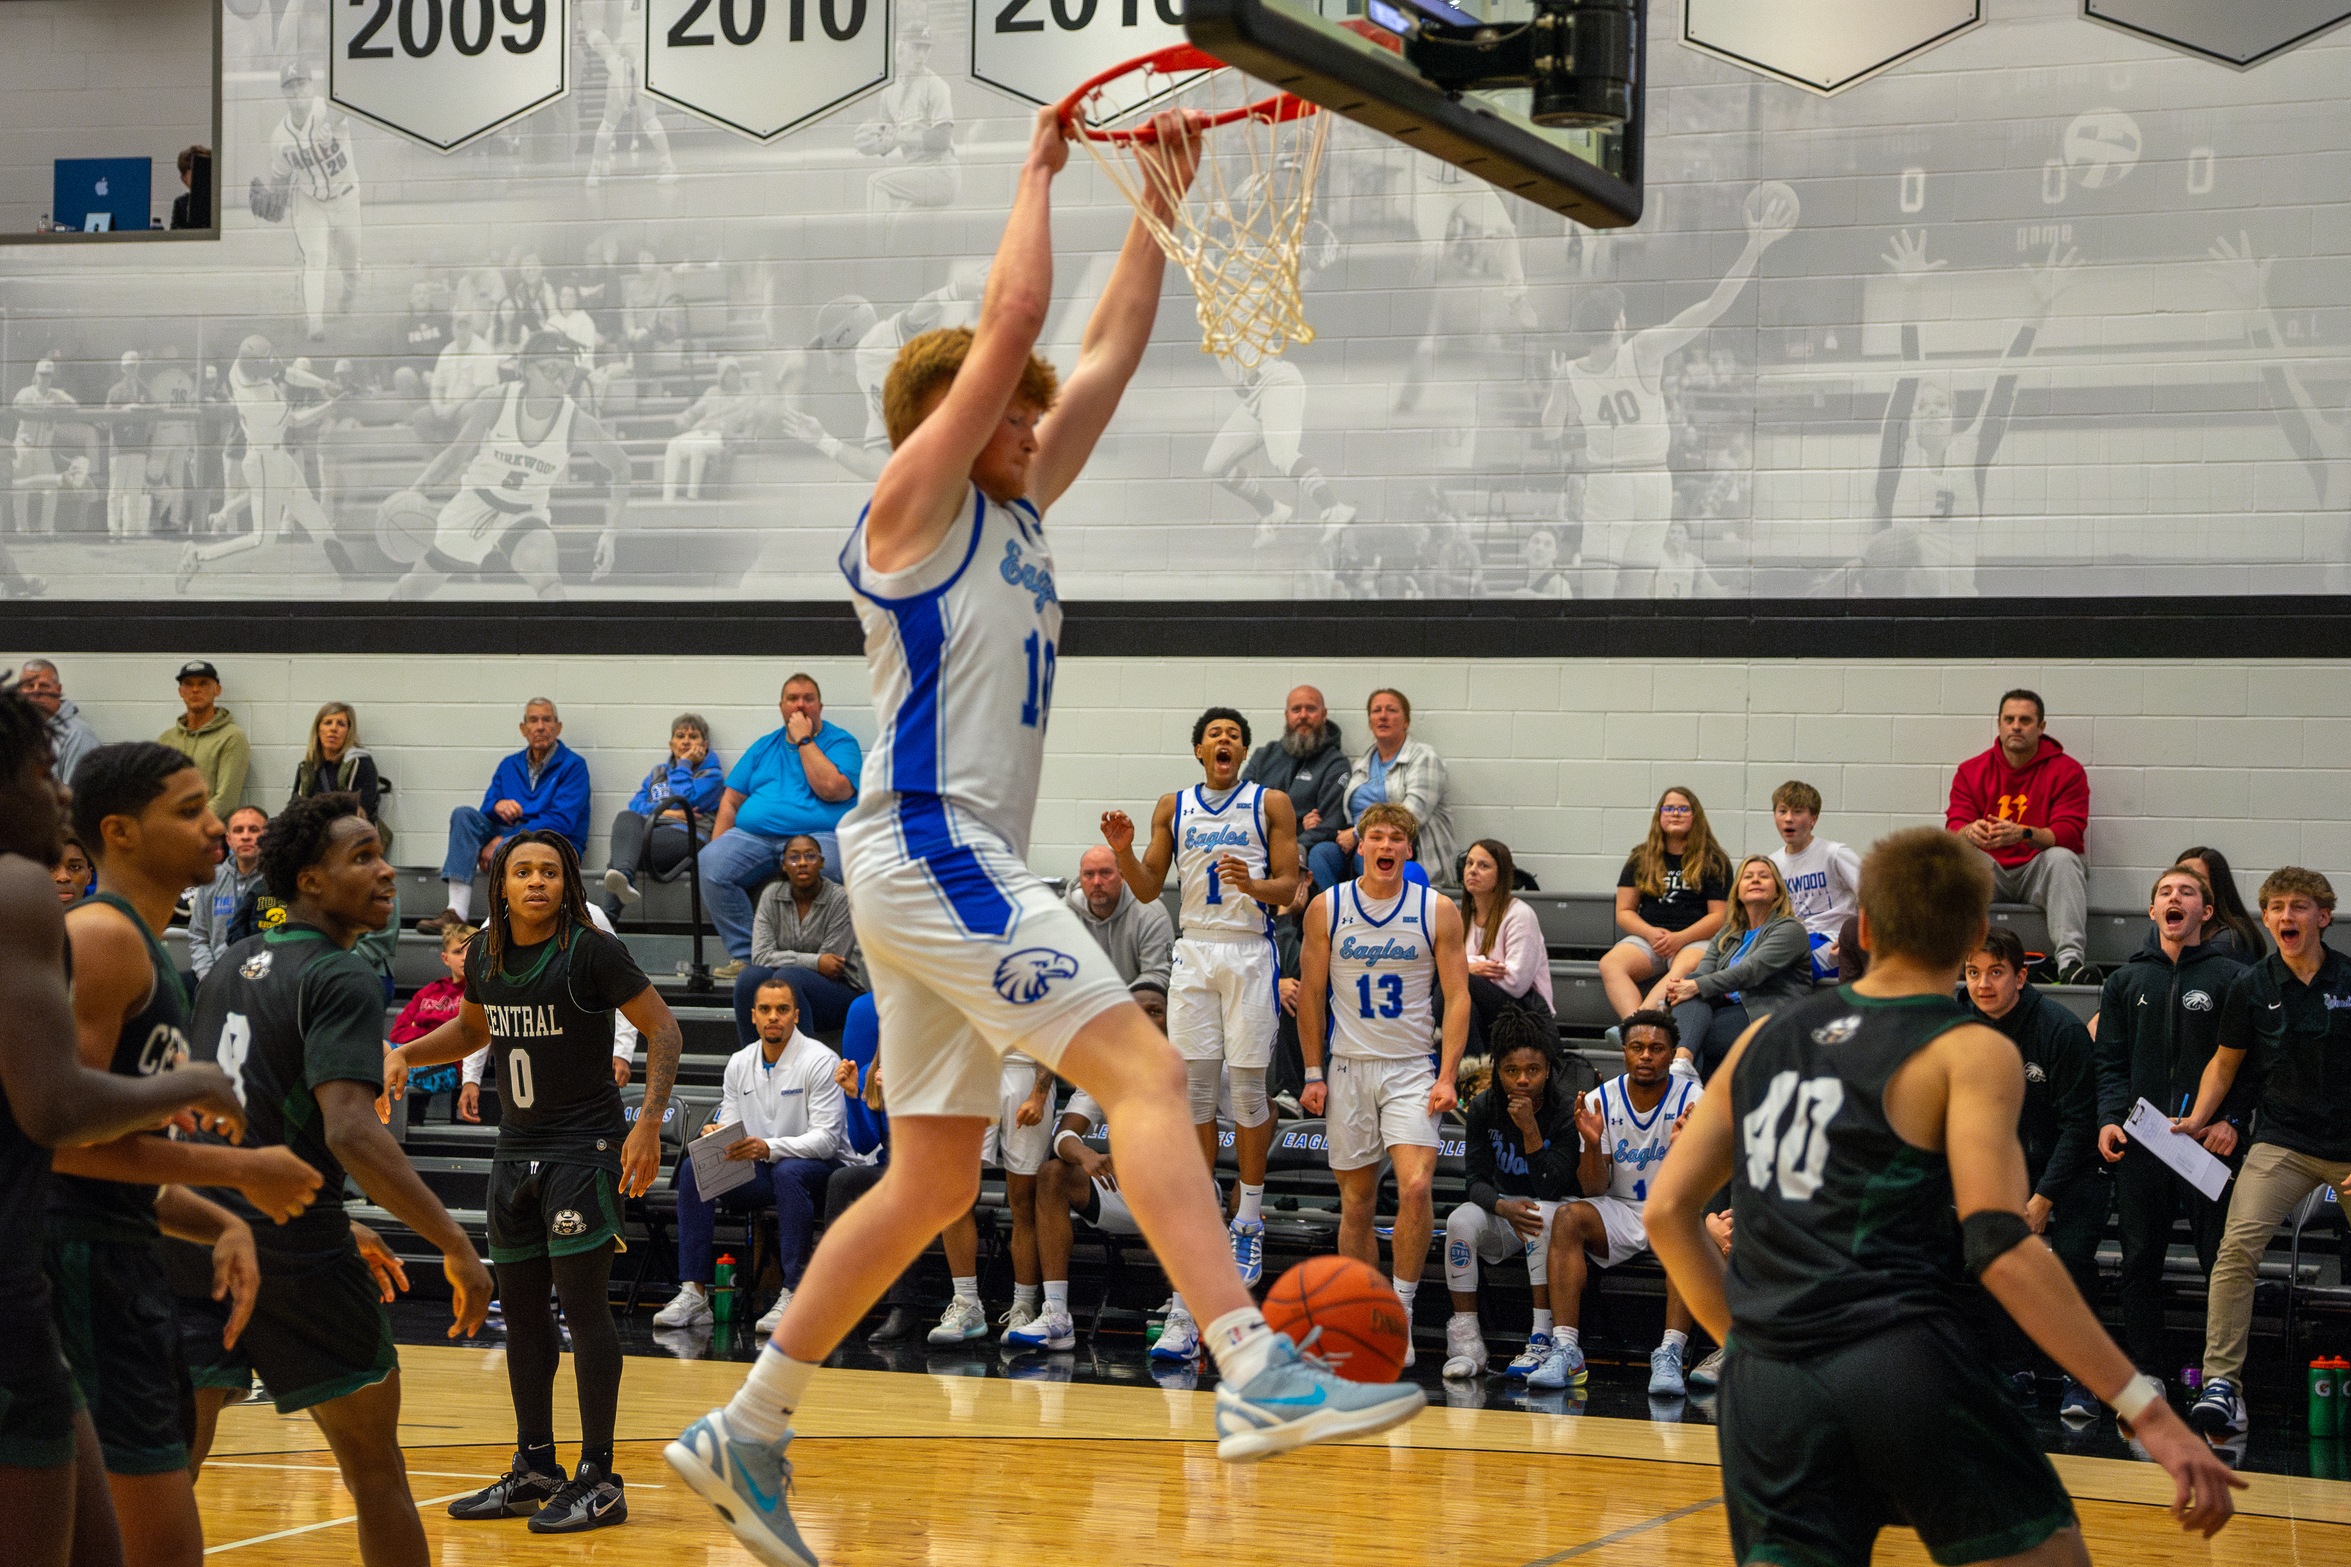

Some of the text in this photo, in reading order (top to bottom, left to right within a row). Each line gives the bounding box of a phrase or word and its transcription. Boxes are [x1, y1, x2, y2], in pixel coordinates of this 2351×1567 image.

[348, 0, 546, 59] 2009
[1598, 389, 1641, 426] 40
[1184, 823, 1250, 854] Eagles
[1206, 860, 1223, 905] 1
[1339, 936, 1419, 967] Eagles
[1356, 973, 1403, 1019] 13
[508, 1048, 534, 1108] 0
[1613, 1138, 1670, 1172] Eagle
[1743, 1069, 1845, 1200] 40
